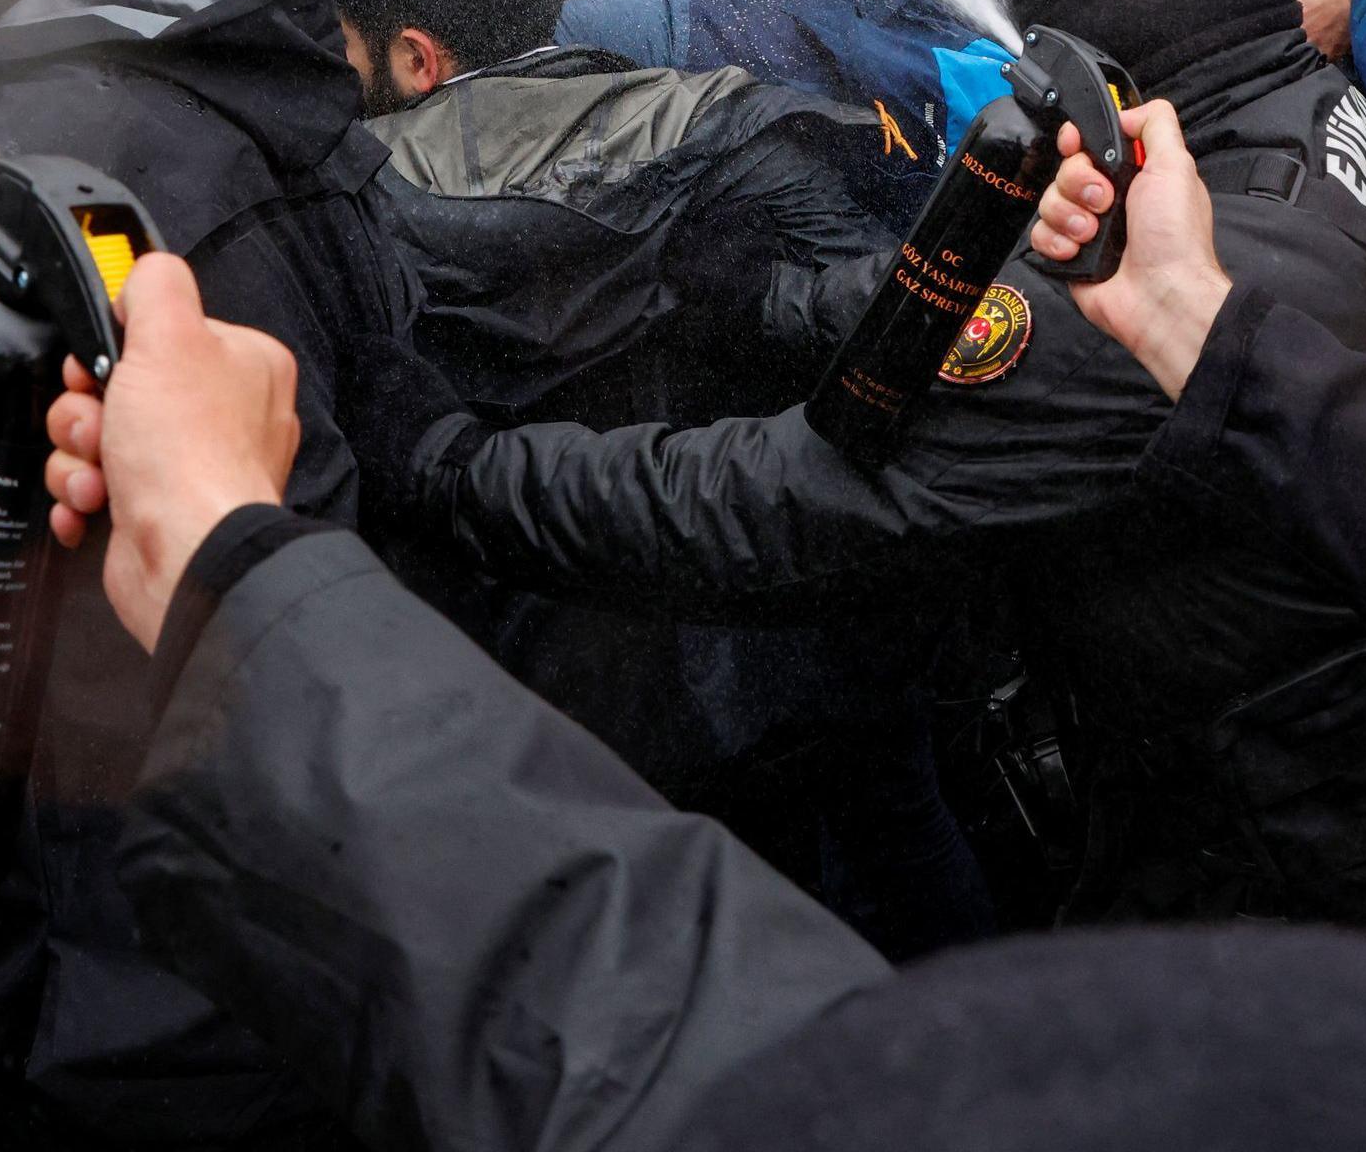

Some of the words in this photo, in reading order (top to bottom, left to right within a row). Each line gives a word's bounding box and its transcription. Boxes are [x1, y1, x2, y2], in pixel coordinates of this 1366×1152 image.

[902, 242, 921, 268] GÖZ
[941, 249, 964, 268] OC
[896, 269, 919, 294] GAZ
